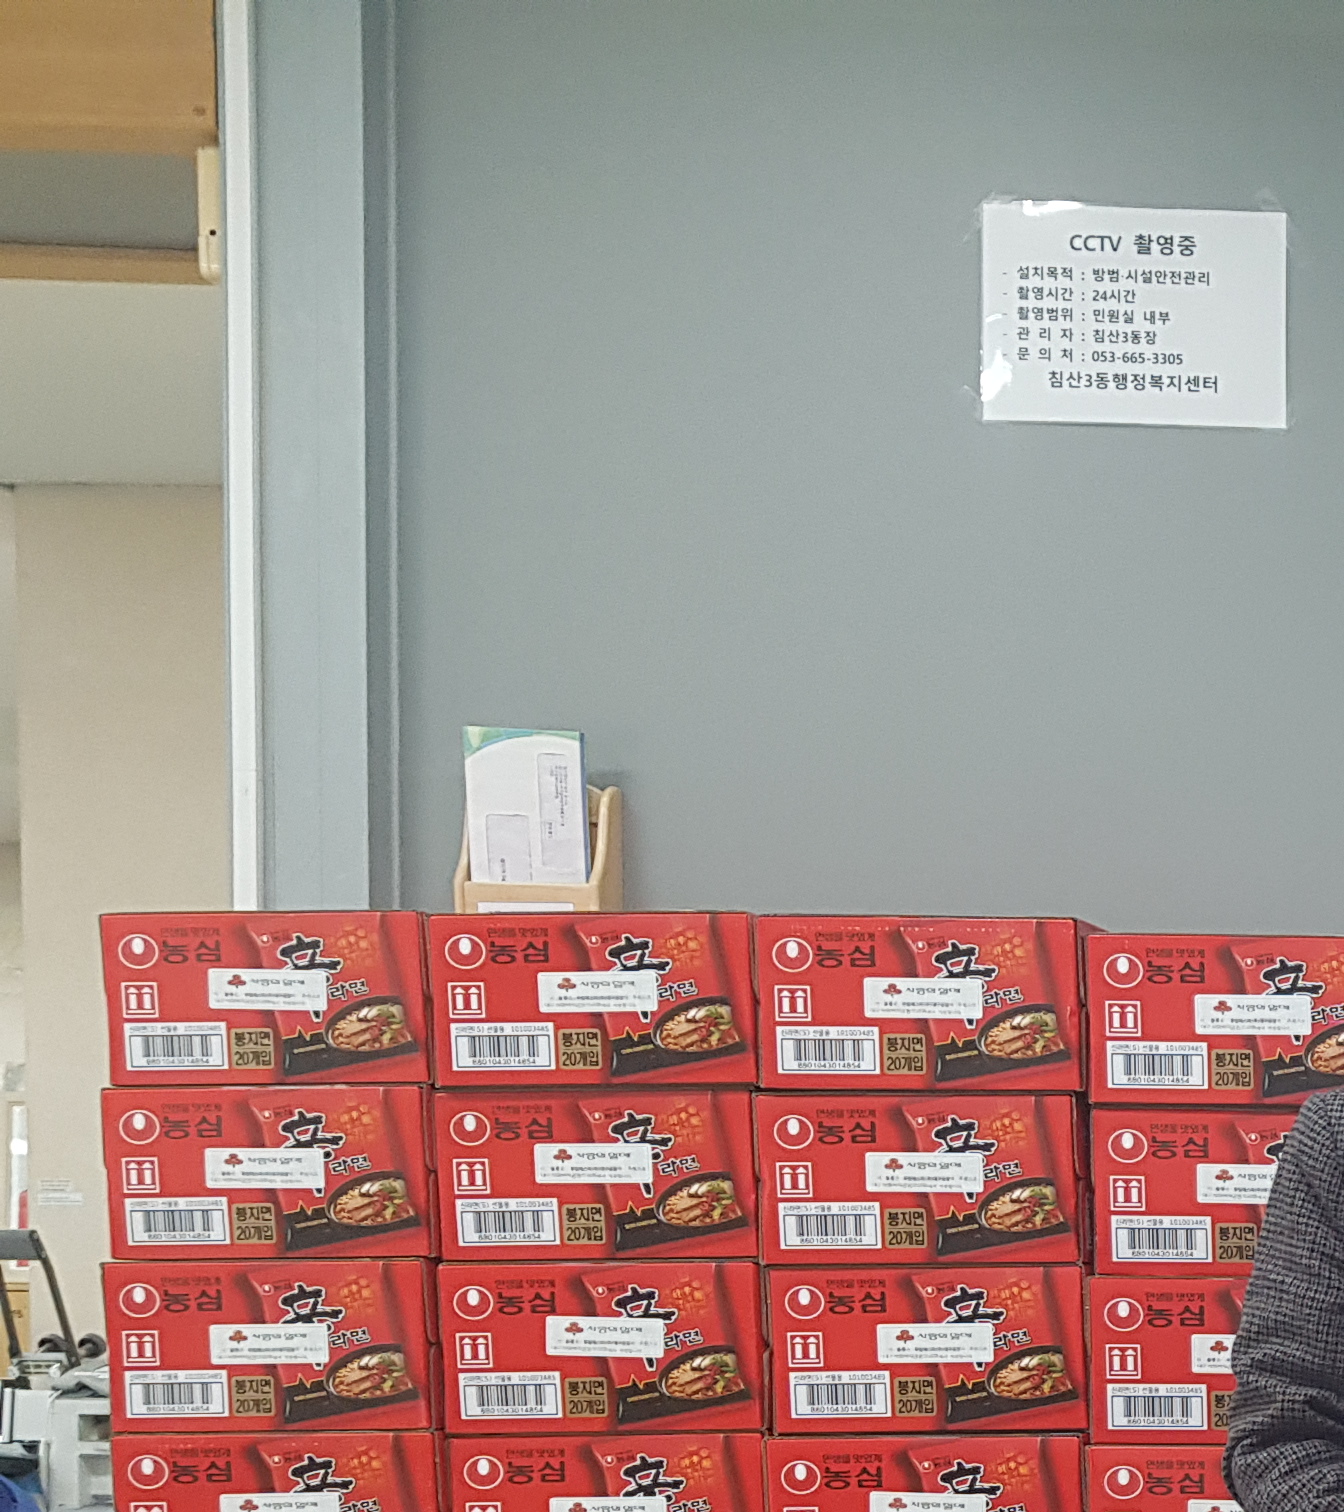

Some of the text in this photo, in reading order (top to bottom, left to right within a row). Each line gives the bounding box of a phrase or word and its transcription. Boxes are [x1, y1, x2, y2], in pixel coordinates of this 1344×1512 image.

[1070, 235, 1197, 257] CCTV 촬영중
[1017, 266, 1073, 281] 설치목적
[1017, 286, 1136, 304] 촬영시간 24시간
[1017, 307, 1171, 325] 촬영범위 민원실 내부
[1093, 329, 1156, 345] 침산3동장
[1092, 351, 1183, 365] 053-665-3305
[1048, 371, 1218, 393] 침산3동행정복지센터
[161, 940, 222, 963] 농심
[489, 941, 550, 964] 농심
[816, 945, 877, 969] 농심
[1146, 962, 1206, 985] 농심
[657, 981, 699, 1001] 라면
[982, 988, 1025, 1008] 라면
[561, 1033, 598, 1048] 봉지면
[886, 1038, 923, 1053] 봉지면
[562, 1051, 599, 1067] 20개입
[887, 1056, 924, 1072] 20개입
[1215, 1053, 1251, 1069] 봉지면
[1215, 1072, 1251, 1088] 20개입
[162, 1117, 223, 1140] 농심
[492, 1117, 553, 1139] 농심
[816, 1122, 877, 1145] 농심
[1149, 1135, 1206, 1158] 농심
[982, 1162, 1024, 1181] 라면
[887, 1212, 924, 1227] 봉지면
[888, 1231, 925, 1247] 20개입
[163, 1290, 224, 1313] 농심
[496, 1291, 557, 1314] 농심
[827, 1292, 887, 1315] 농심
[1145, 1304, 1203, 1327] 농심
[663, 1329, 705, 1348] 라면
[991, 1331, 1032, 1350] 라면
[568, 1381, 605, 1396] 봉지면
[897, 1381, 933, 1396] 봉지면
[569, 1399, 606, 1415] 20개입
[898, 1399, 934, 1415] 20개입
[171, 1462, 233, 1484] 농심
[506, 1462, 566, 1484] 농심
[823, 1466, 884, 1488] 농심
[1145, 1472, 1204, 1494] 농심
